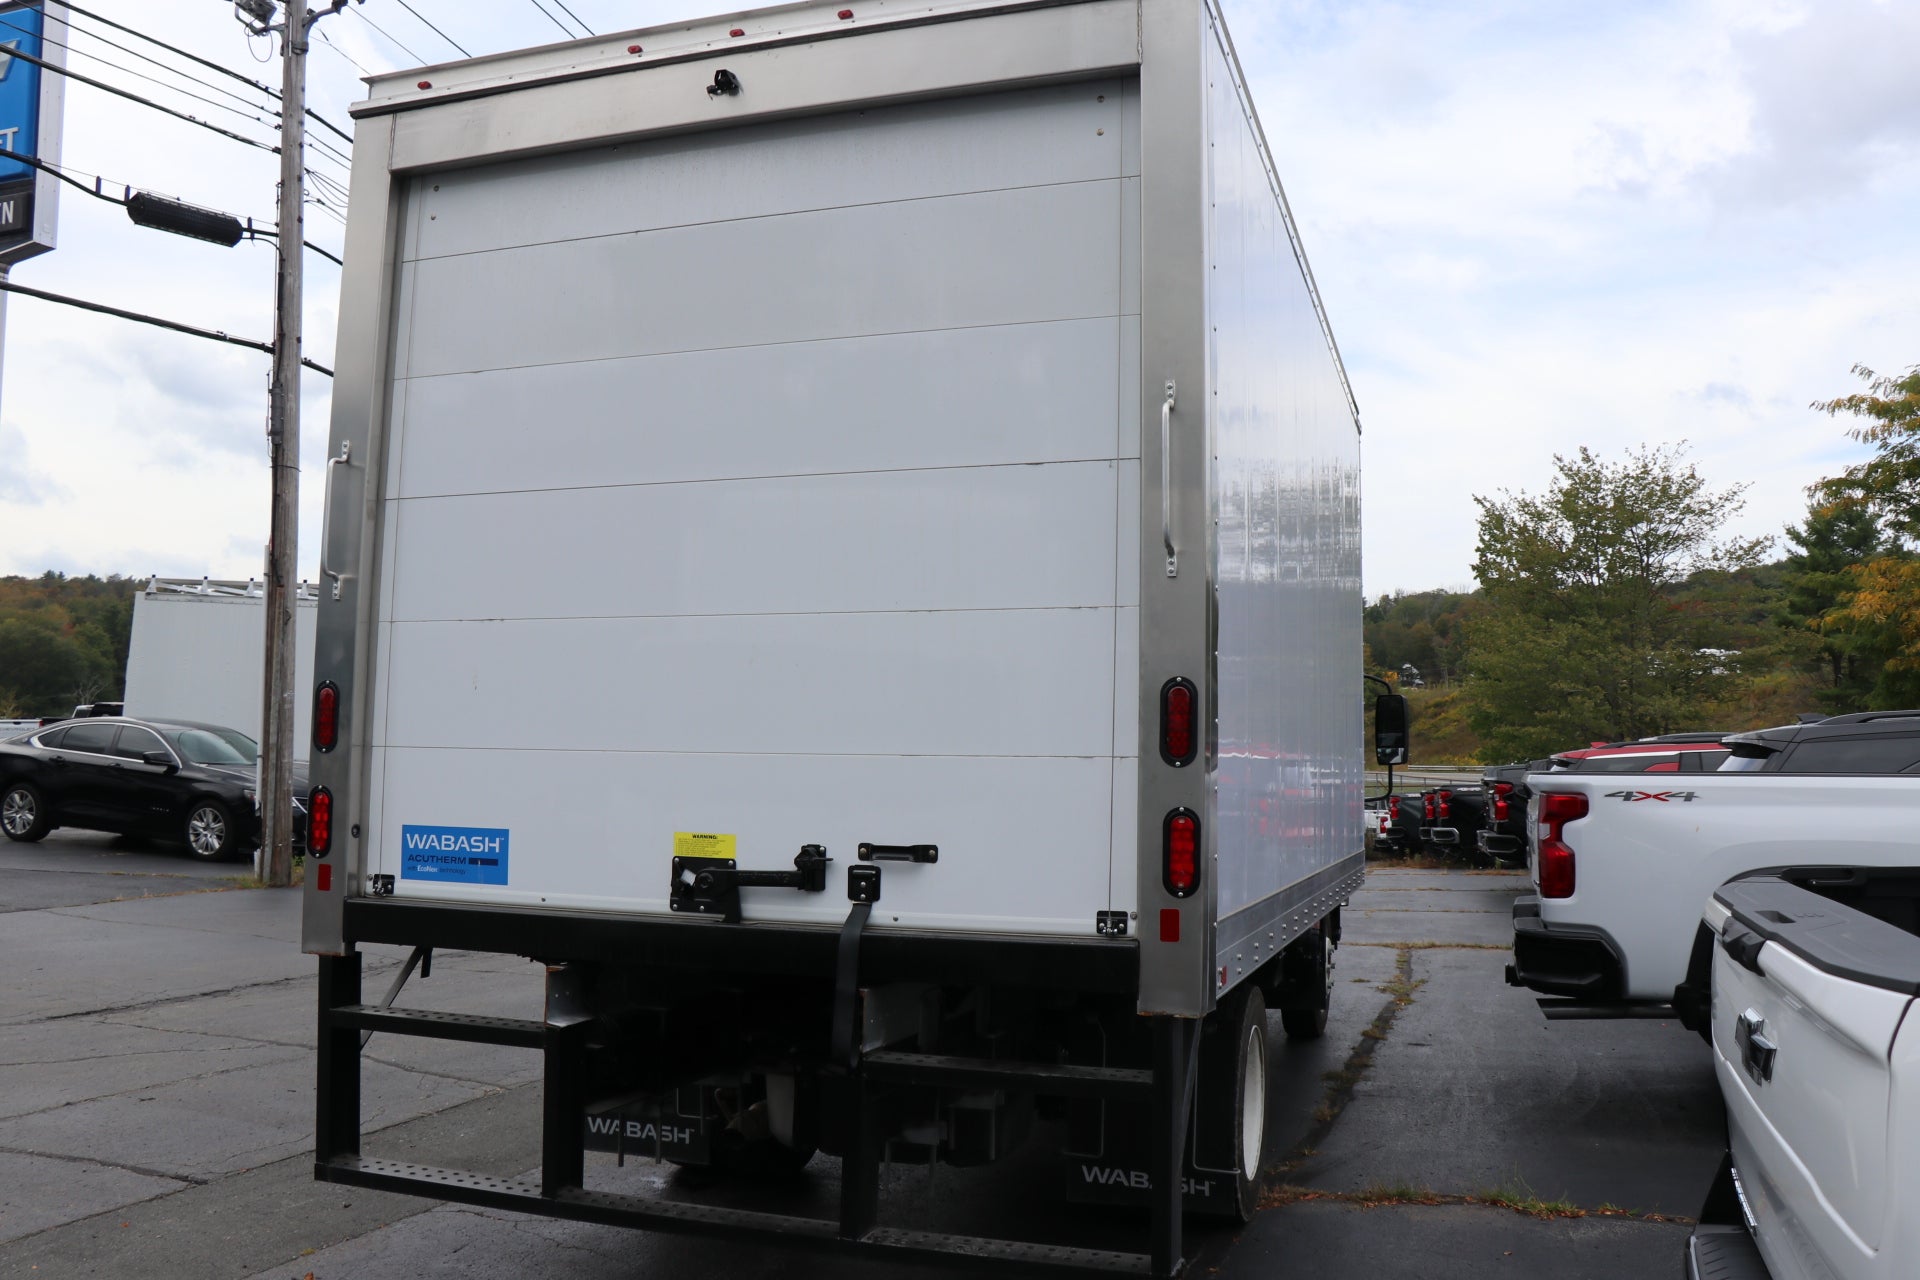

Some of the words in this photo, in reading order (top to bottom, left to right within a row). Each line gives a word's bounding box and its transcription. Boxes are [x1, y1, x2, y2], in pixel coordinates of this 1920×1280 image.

[0, 126, 19, 152] T
[0, 200, 14, 225] N
[406, 833, 500, 853] WABASH
[408, 854, 467, 865] ACUTHERM
